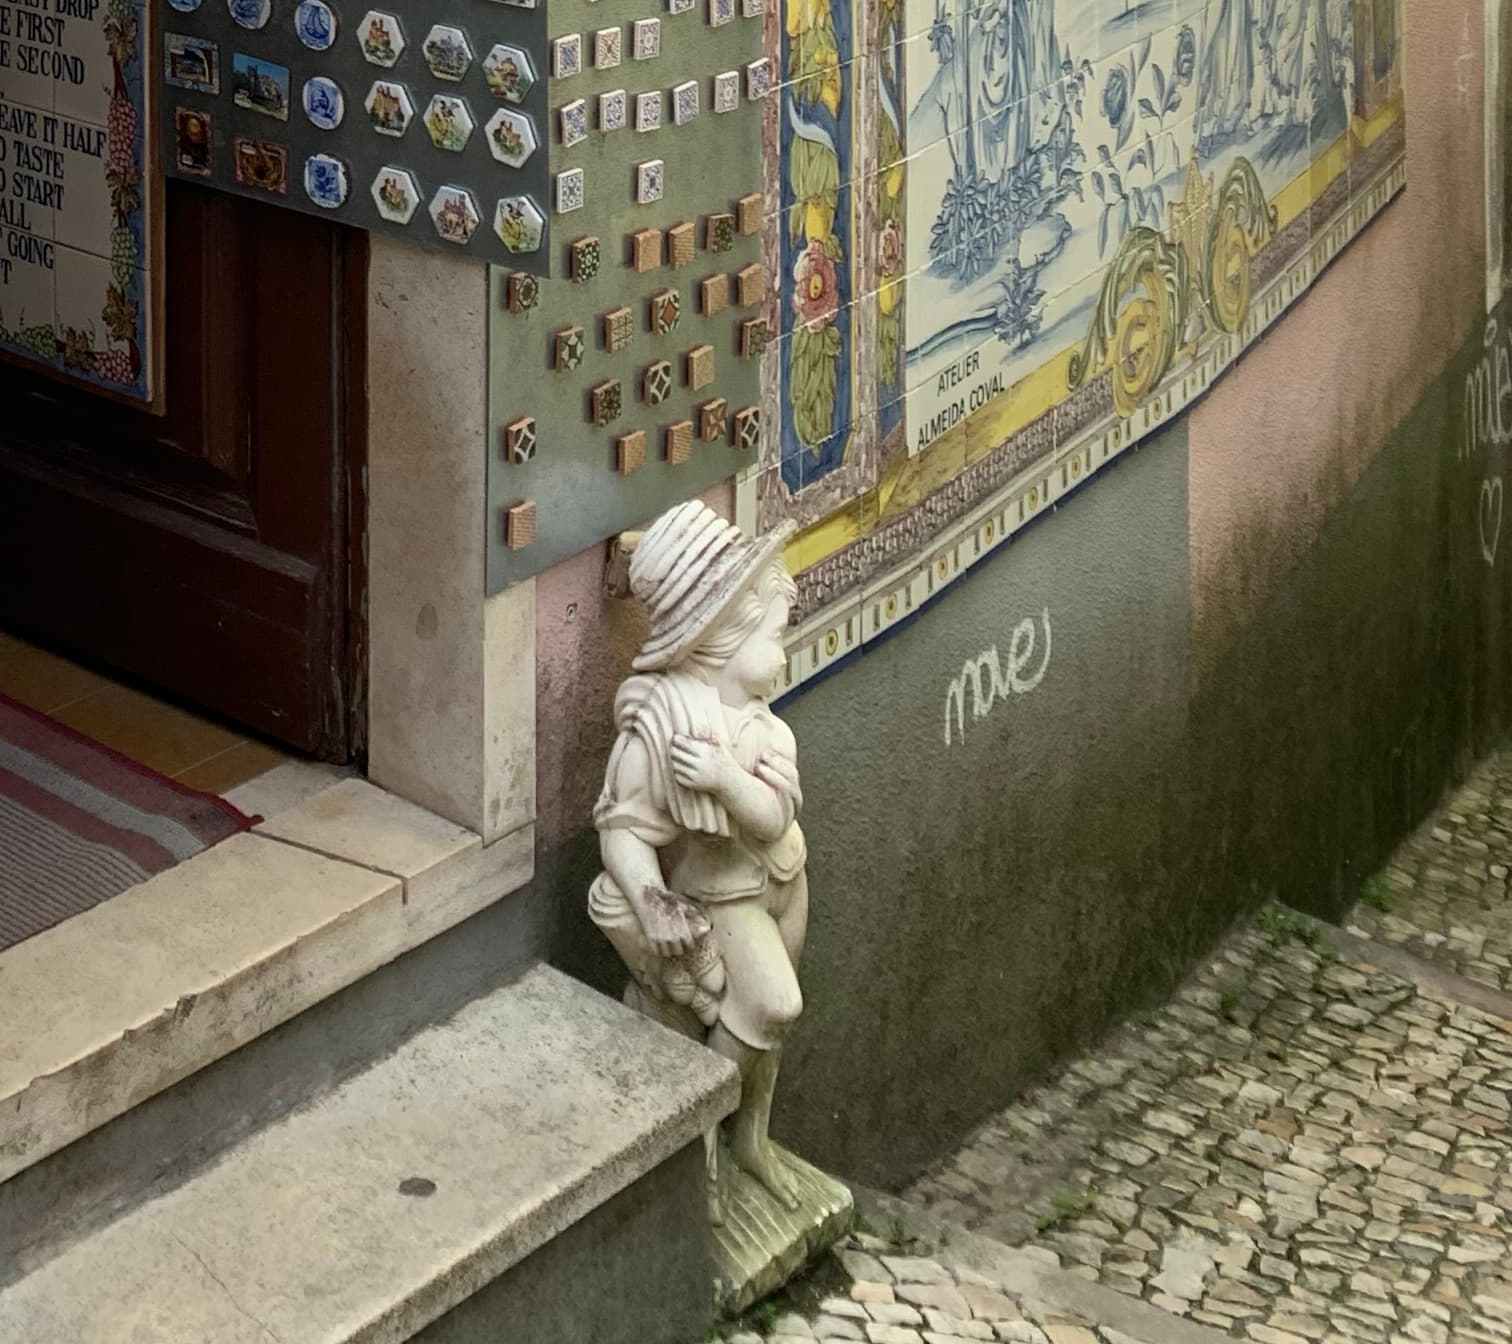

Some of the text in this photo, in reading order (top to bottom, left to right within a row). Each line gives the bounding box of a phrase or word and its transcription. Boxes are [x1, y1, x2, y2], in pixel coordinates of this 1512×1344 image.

[16, 9, 65, 47] FIRST
[17, 44, 85, 85] SECOND
[43, 116, 58, 144] IT
[63, 122, 107, 158] HALF
[13, 141, 64, 180] TASTE
[13, 172, 64, 210] START
[8, 232, 55, 269] GOING
[936, 350, 981, 398] ATELIER
[917, 372, 1006, 451] ALMEIDA COVAL
